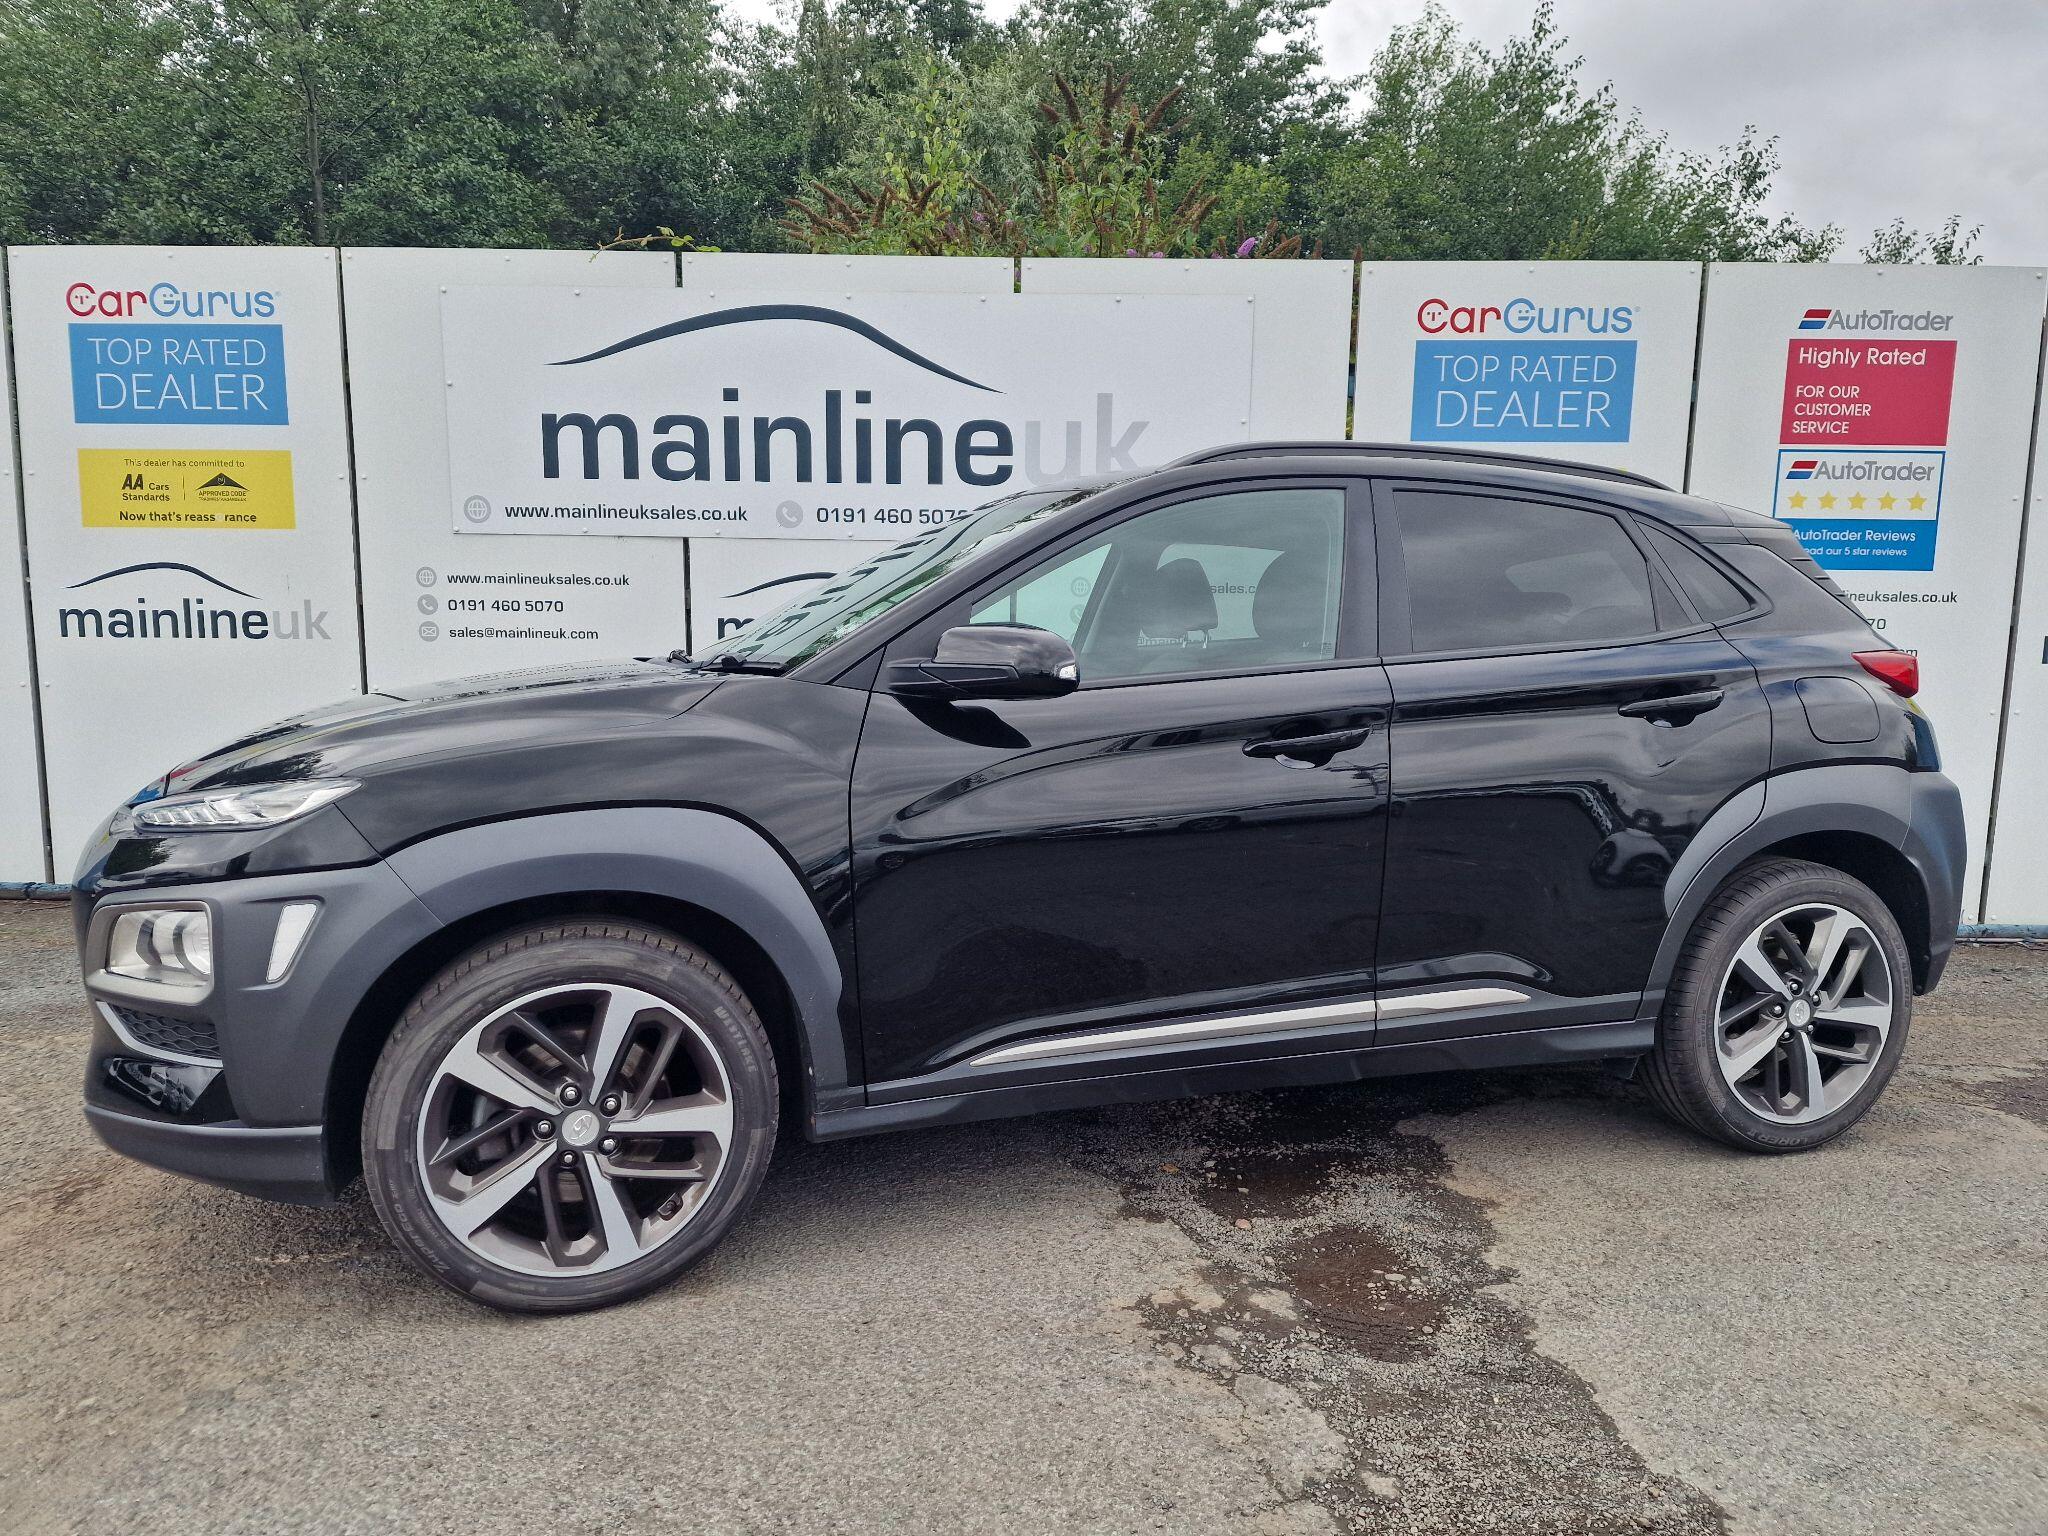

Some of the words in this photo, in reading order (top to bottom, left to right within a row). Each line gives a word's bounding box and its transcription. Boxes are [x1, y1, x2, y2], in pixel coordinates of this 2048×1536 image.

[66, 283, 274, 317] CarGurus
[1418, 298, 1631, 333] CarGurus
[1827, 309, 1953, 331] AutoTrader
[87, 338, 152, 365] TOP
[163, 338, 267, 366] RATED
[1799, 347, 1861, 369] Highly
[1867, 347, 1926, 365] Rated
[1434, 355, 1499, 383] TOP
[1510, 355, 1617, 383] RATED
[95, 373, 269, 411] DEALER
[1797, 386, 1824, 397] FOR
[1828, 386, 1860, 399] OUR
[1437, 391, 1610, 427] DEALER
[1794, 402, 1872, 417] CUSTOMER
[1792, 420, 1850, 434] SERVICE
[125, 458, 142, 467] This
[144, 458, 170, 468] dealer
[172, 459, 187, 467] has
[189, 460, 234, 468] committed
[1814, 461, 1935, 481] AutoTrader
[122, 474, 143, 490] AA
[122, 493, 170, 501] Standards
[119, 511, 146, 521] Now
[149, 511, 182, 522] that's
[184, 513, 257, 523] reassrance
[504, 504, 748, 522] www.mainlineuksales.co.uk
[816, 507, 866, 524] 0191
[874, 508, 913, 524] 460
[919, 509, 968, 524] 507
[1794, 529, 1862, 541] AutoTrader
[1865, 530, 1916, 542] Reviews
[1804, 547, 1824, 555] ead
[1825, 548, 1843, 556] our
[1844, 547, 1851, 556] 5
[1852, 547, 1871, 556] star
[448, 573, 629, 585] www.mainlineuksales.co.uk
[448, 600, 484, 610] 0191
[492, 601, 520, 611] 460
[525, 601, 563, 612] 5070
[59, 598, 332, 640] mainlineuk
[450, 627, 598, 639] sales@mainlineuk.com
